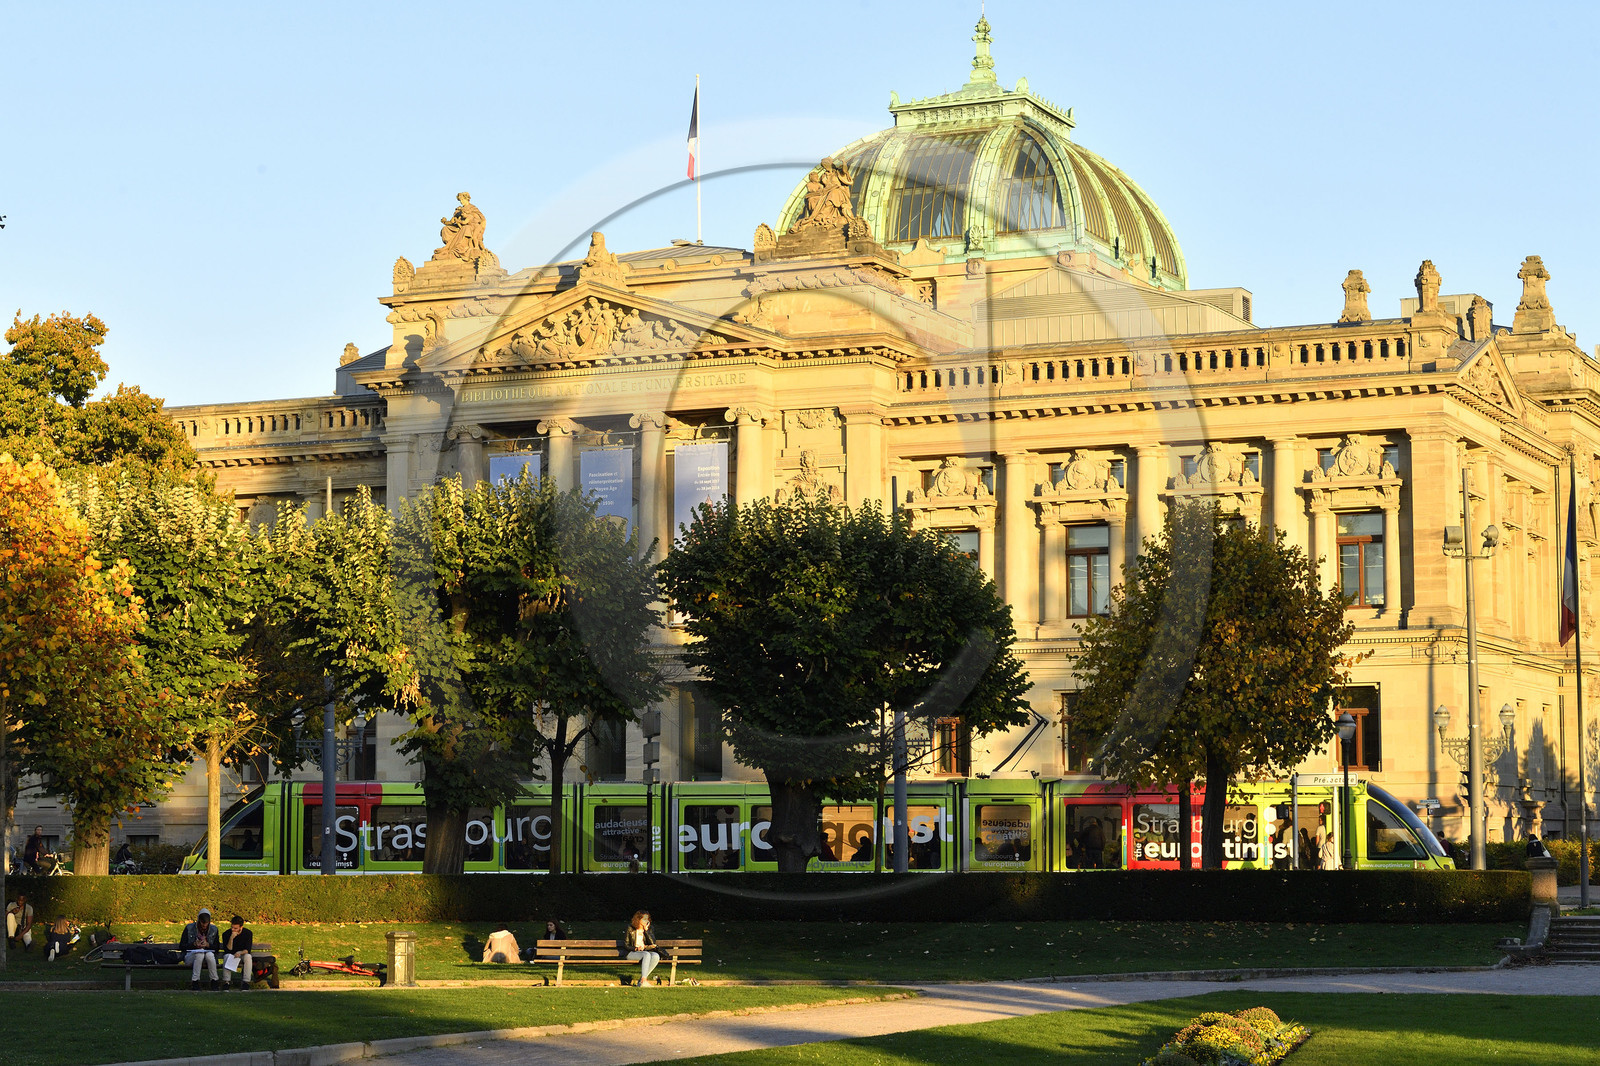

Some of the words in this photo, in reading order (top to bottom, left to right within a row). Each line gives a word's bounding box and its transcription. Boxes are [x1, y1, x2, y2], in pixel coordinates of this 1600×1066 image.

[557, 382, 628, 397] NATIONALE
[646, 373, 747, 390] UNIVERSITAIRE
[335, 815, 552, 853] Strasourg
[595, 819, 647, 829] audacieuse
[602, 828, 640, 836] attractive
[1137, 813, 1257, 839] Straburg
